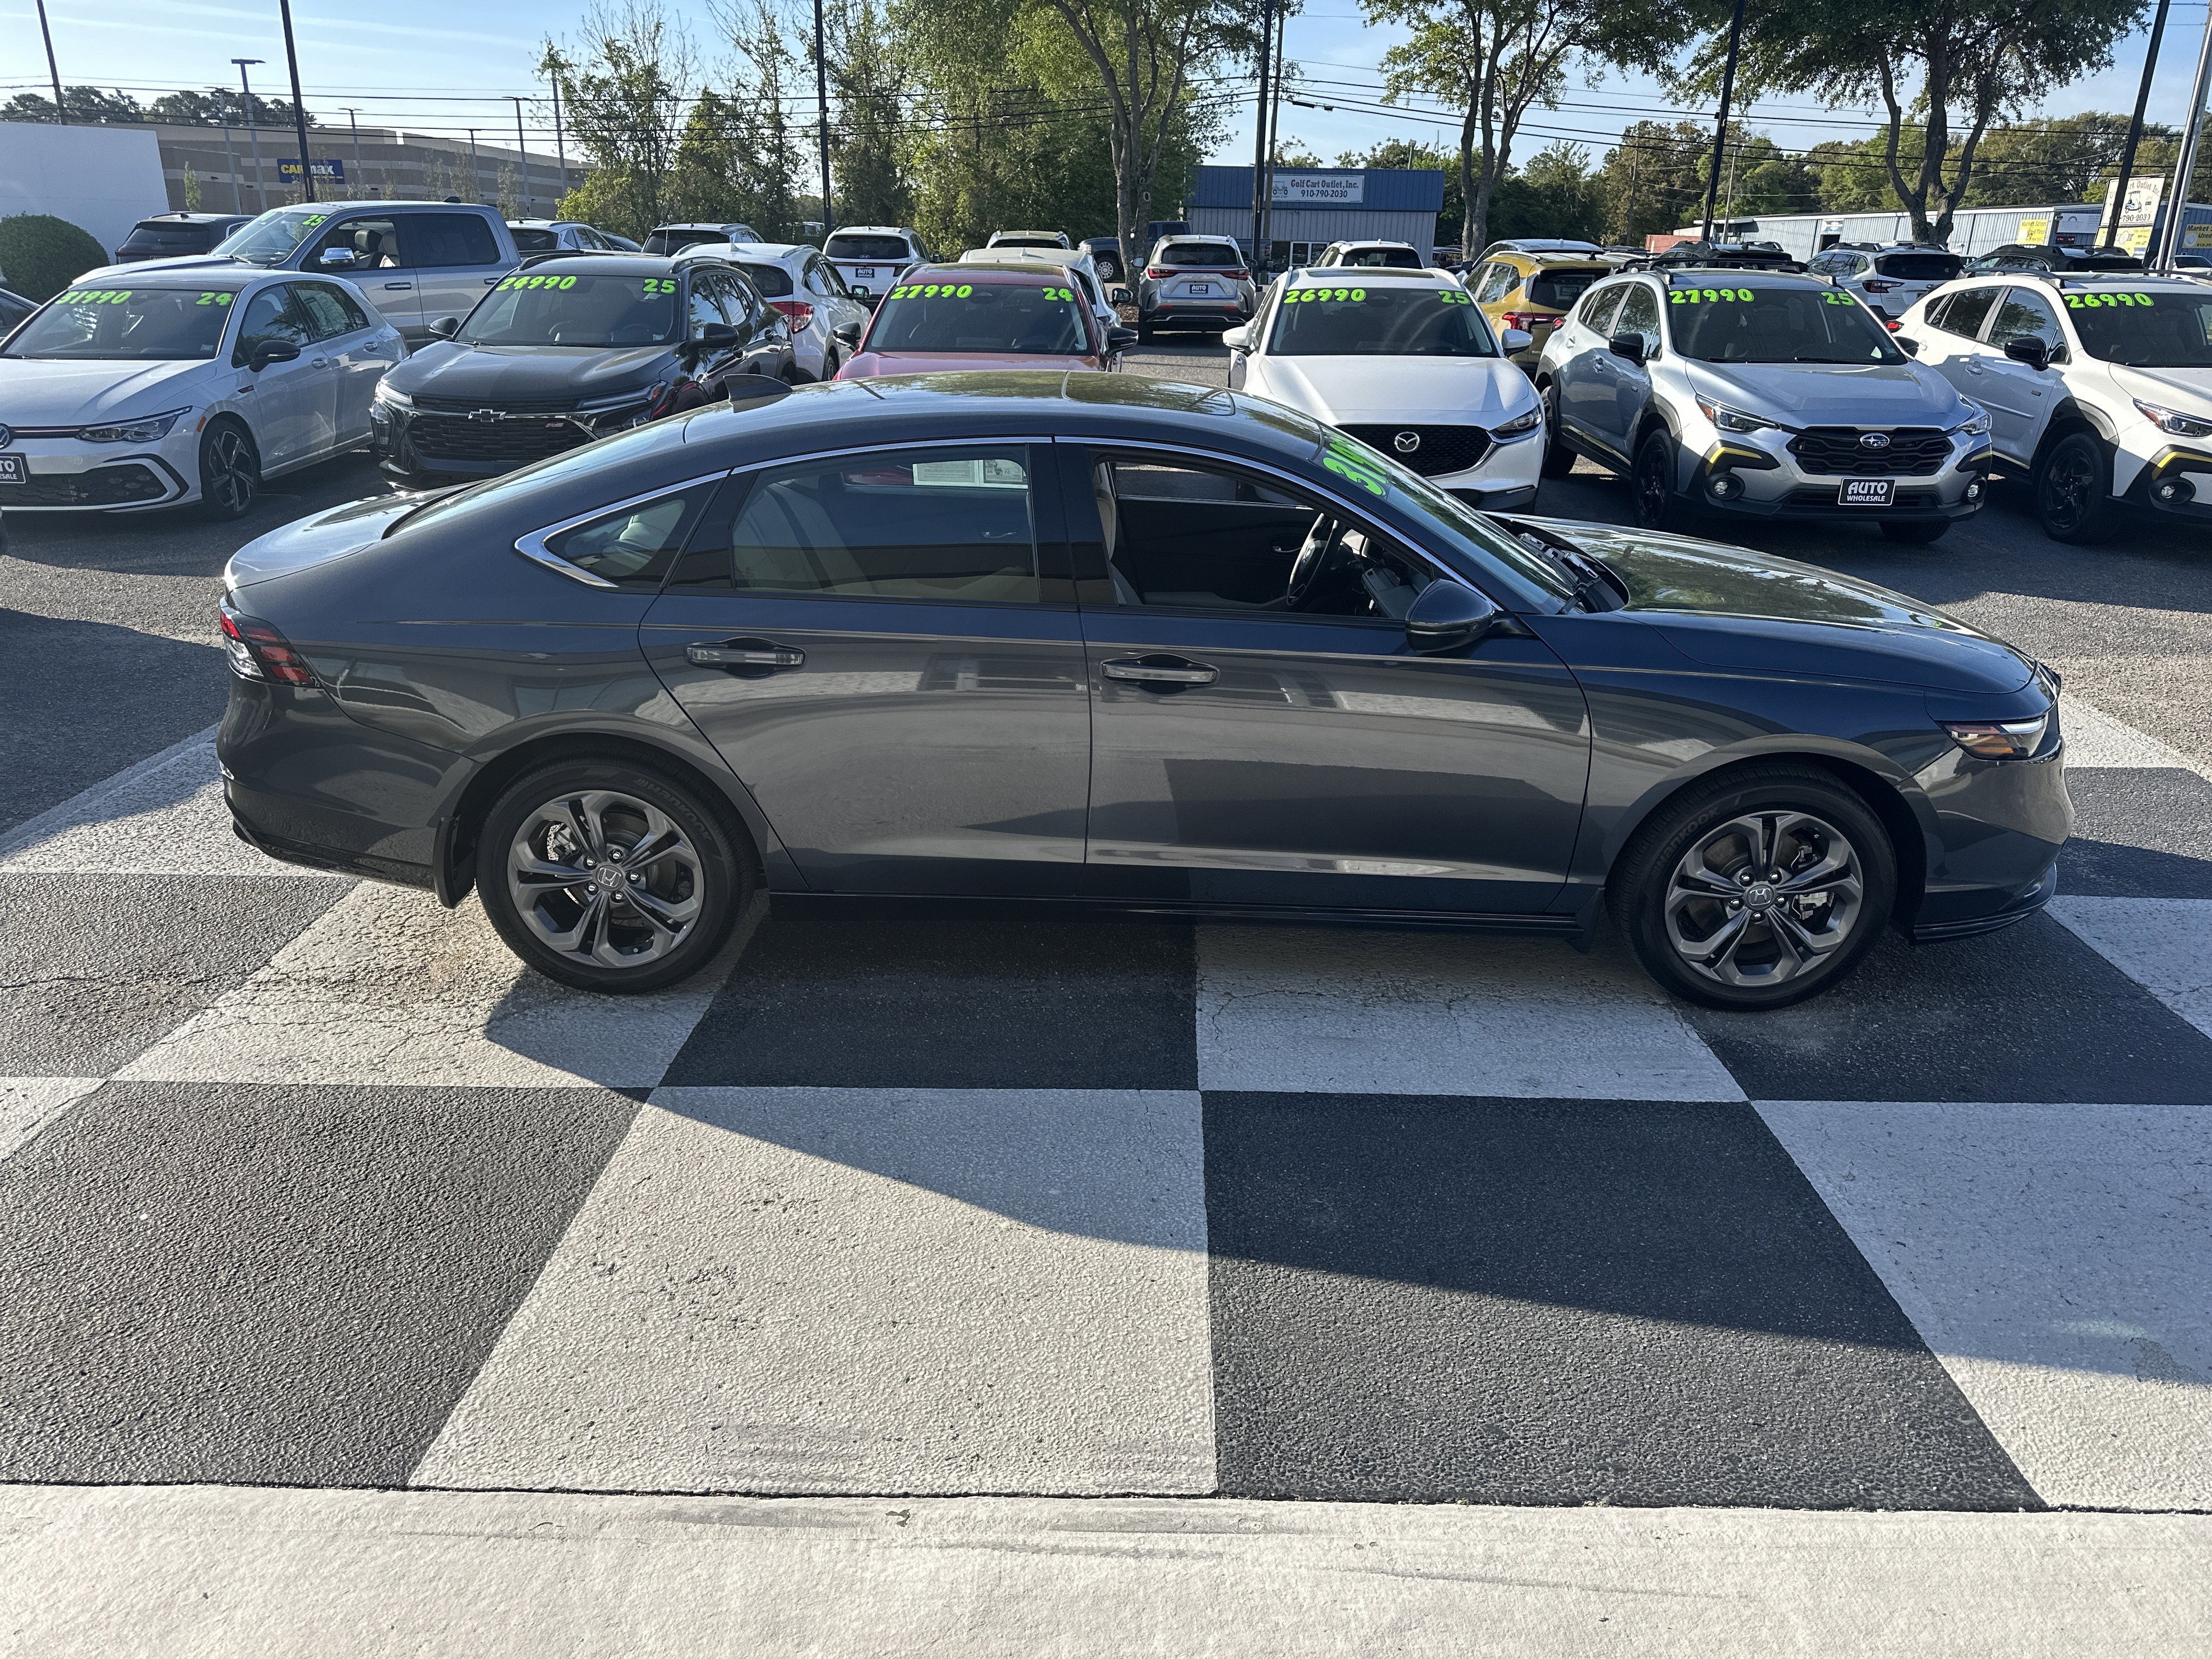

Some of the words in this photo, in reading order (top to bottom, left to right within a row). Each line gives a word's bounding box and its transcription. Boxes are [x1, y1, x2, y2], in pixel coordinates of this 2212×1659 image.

[1321, 180, 1345, 189] Outlet,
[2137, 180, 2152, 190] Outlet
[302, 215, 328, 227] 25
[496, 275, 577, 291] 24990
[643, 278, 676, 294] 25
[55, 291, 133, 304] 31990
[195, 292, 233, 306] 24
[890, 285, 973, 299] 27990
[1042, 287, 1074, 302] 24
[1284, 289, 1367, 303] 26990
[1438, 290, 1471, 305] 25
[1669, 289, 1754, 304] 27990
[1820, 291, 1856, 306] 25
[2063, 293, 2154, 308] 26990
[1848, 482, 1888, 495] AUTO
